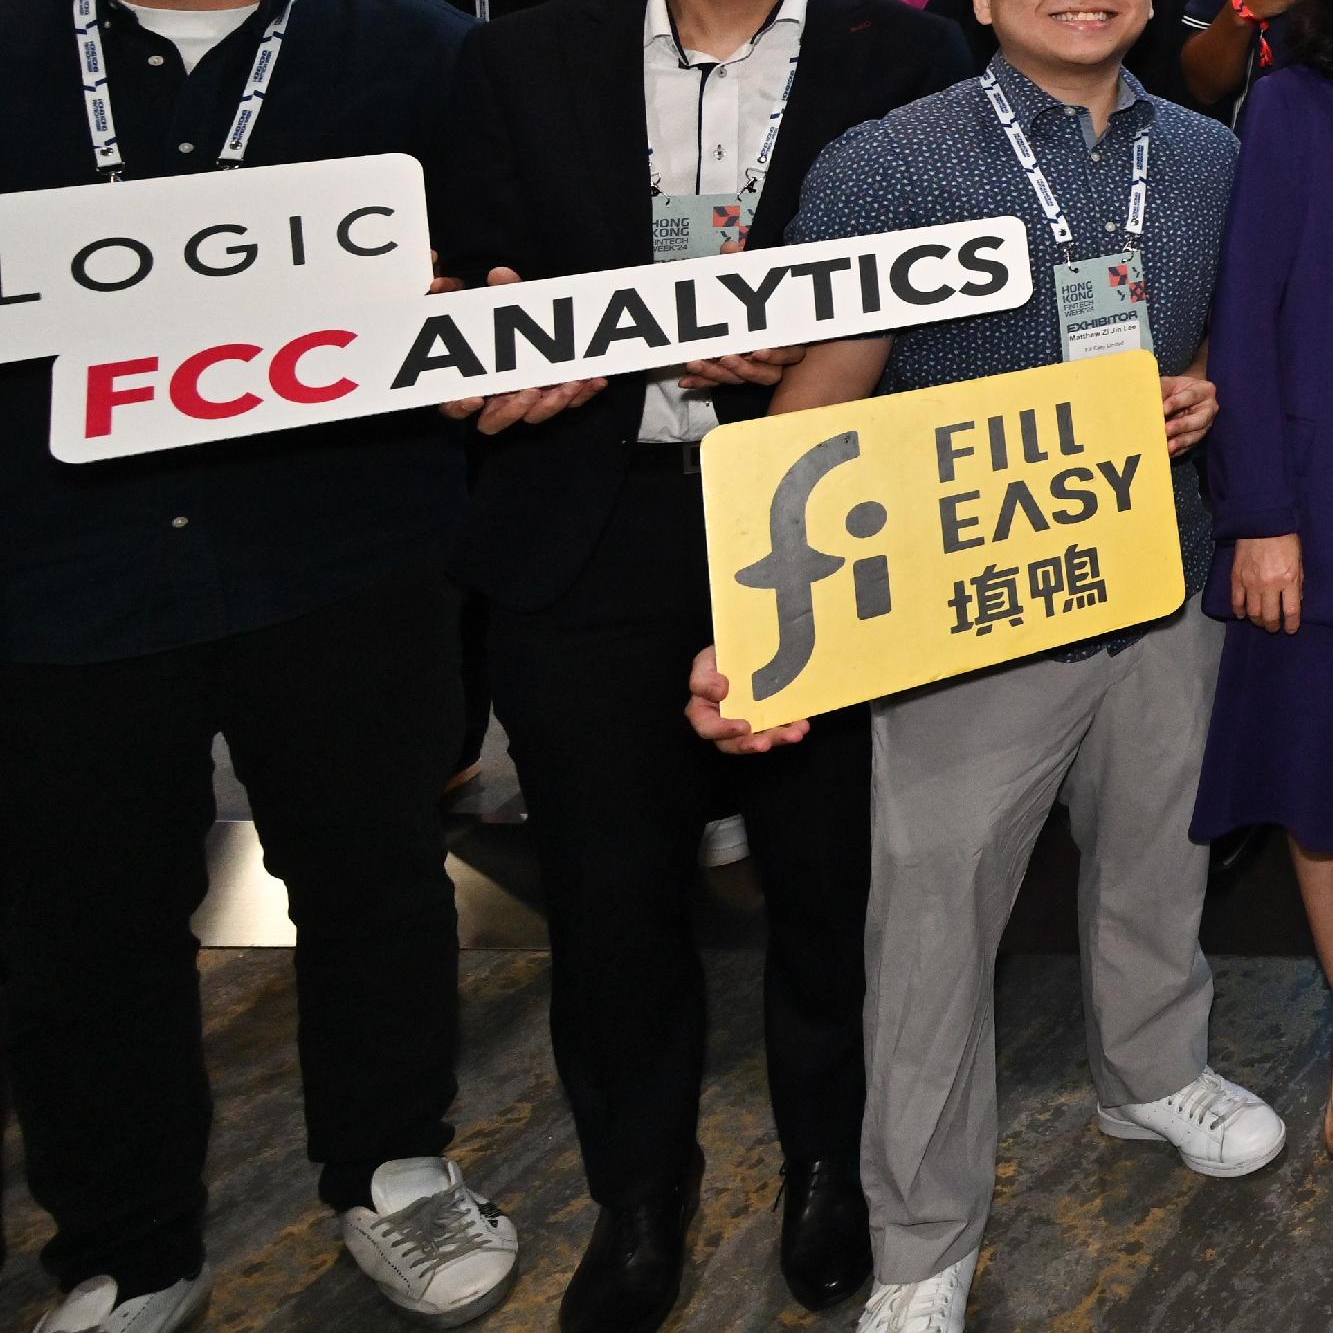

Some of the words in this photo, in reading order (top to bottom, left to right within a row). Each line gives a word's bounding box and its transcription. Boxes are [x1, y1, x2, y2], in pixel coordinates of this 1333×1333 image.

[652, 237, 689, 246] INTECH
[1062, 280, 1093, 295] HONG
[1062, 289, 1094, 303] KONG
[85, 329, 360, 439] FCC
[390, 234, 1010, 389] ANALYTICS
[1066, 310, 1138, 334] EXHIBITOR
[934, 401, 1085, 483] FILL
[938, 453, 1142, 555] EASY
[947, 543, 1108, 638] 填鴨
